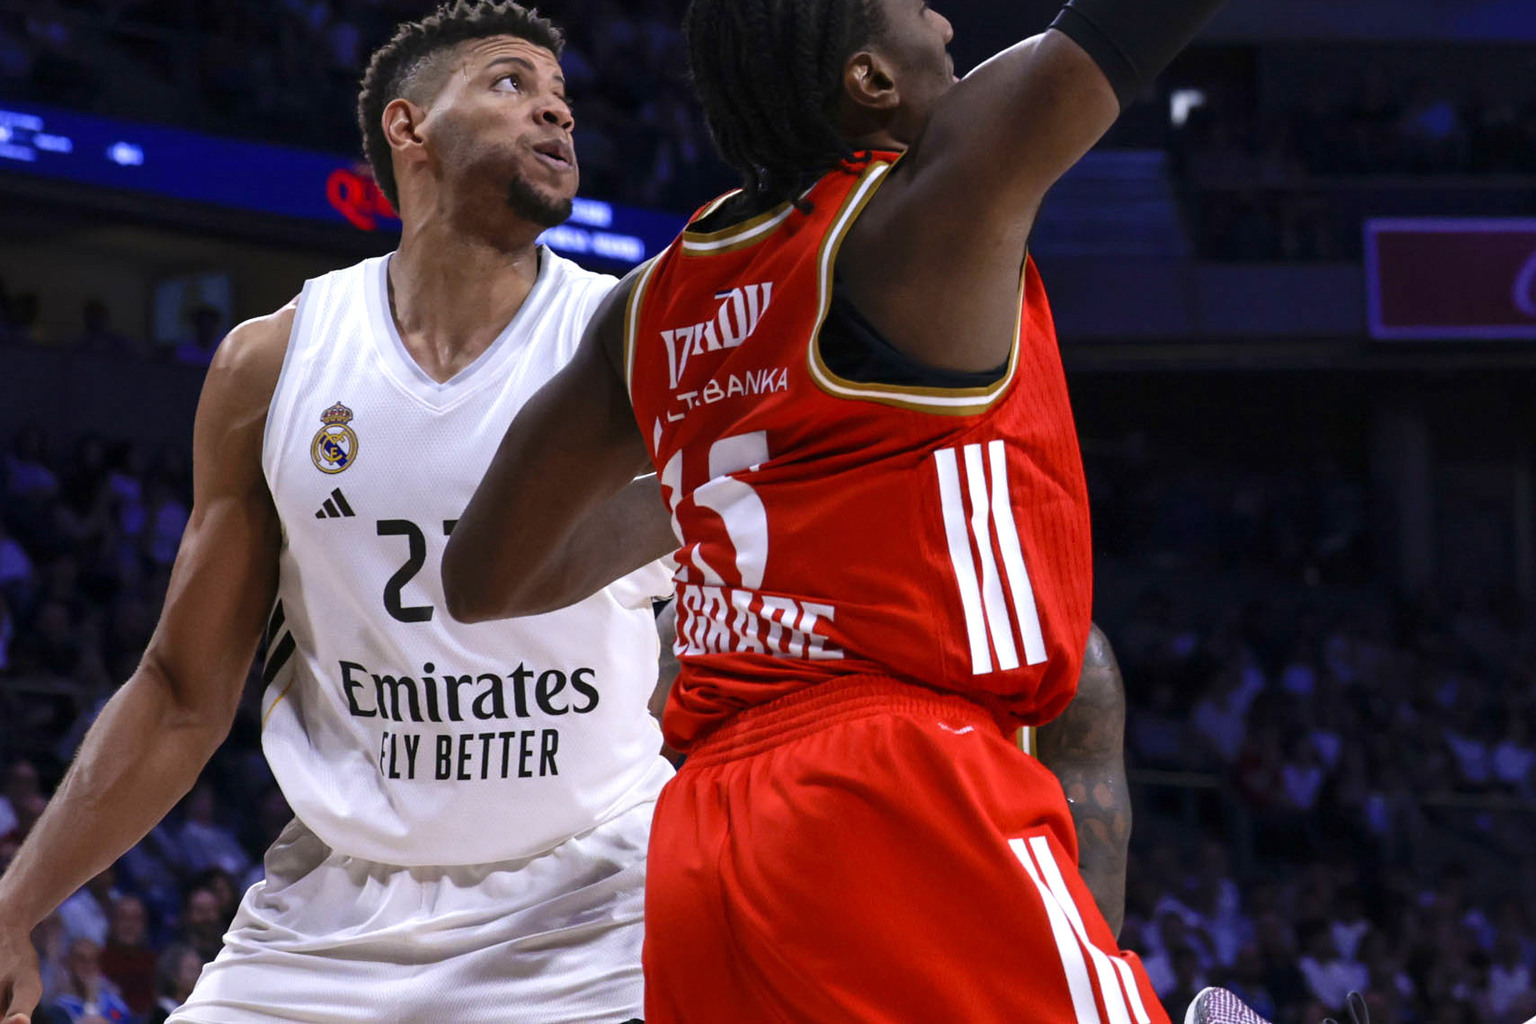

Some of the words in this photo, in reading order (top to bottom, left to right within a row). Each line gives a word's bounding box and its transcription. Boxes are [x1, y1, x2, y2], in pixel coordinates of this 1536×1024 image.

[702, 367, 788, 405] BANKA
[338, 660, 600, 723] Emirates
[434, 728, 560, 782] BETTER
